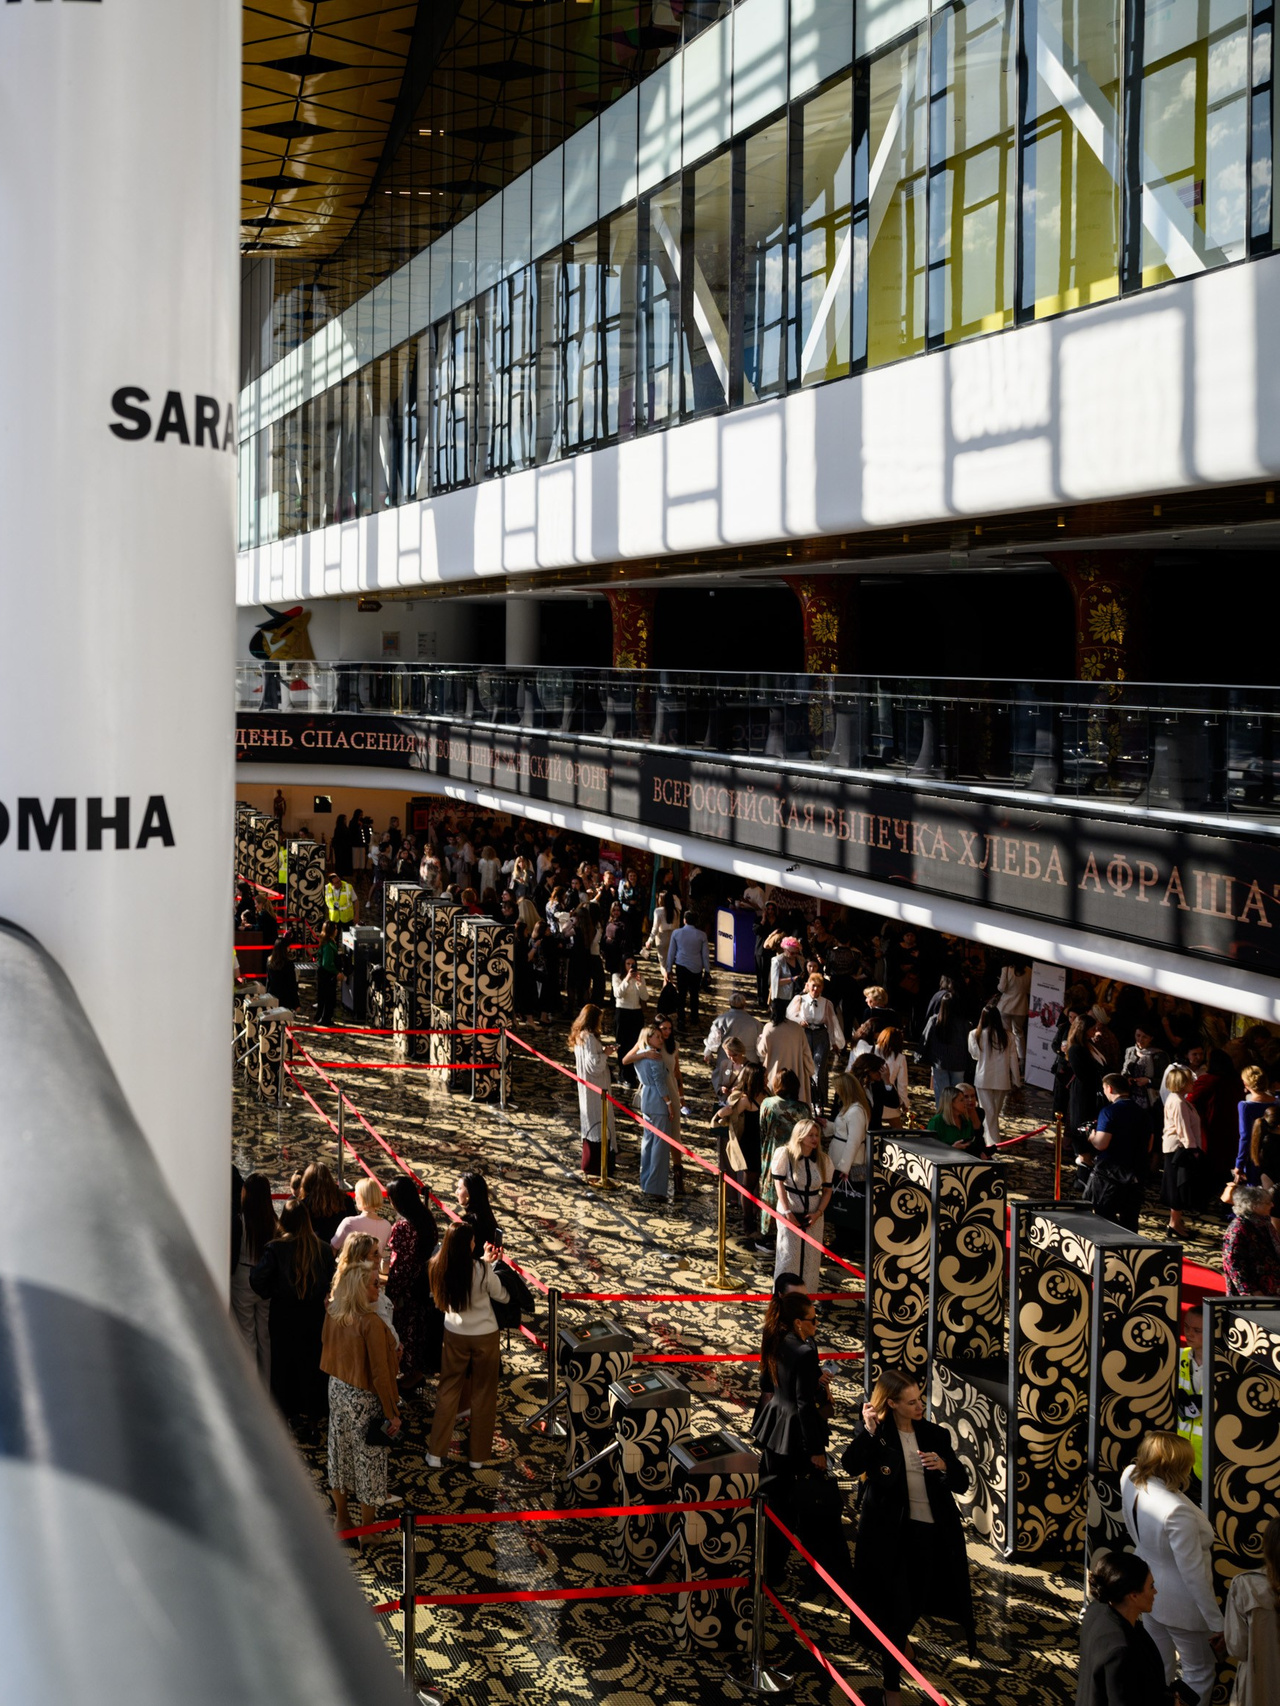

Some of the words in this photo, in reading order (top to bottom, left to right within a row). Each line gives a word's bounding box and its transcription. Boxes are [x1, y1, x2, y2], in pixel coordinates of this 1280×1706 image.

[235, 728, 294, 750] ДЕНЬ
[301, 730, 416, 753] СПАСЕНИЯ
[652, 776, 816, 834] ВСЕРОССИЙСКАЯ
[822, 805, 950, 862] ВЫПЕЧКА
[957, 829, 1068, 887] ХЛЕБА
[1077, 851, 1280, 928] АФРАША
